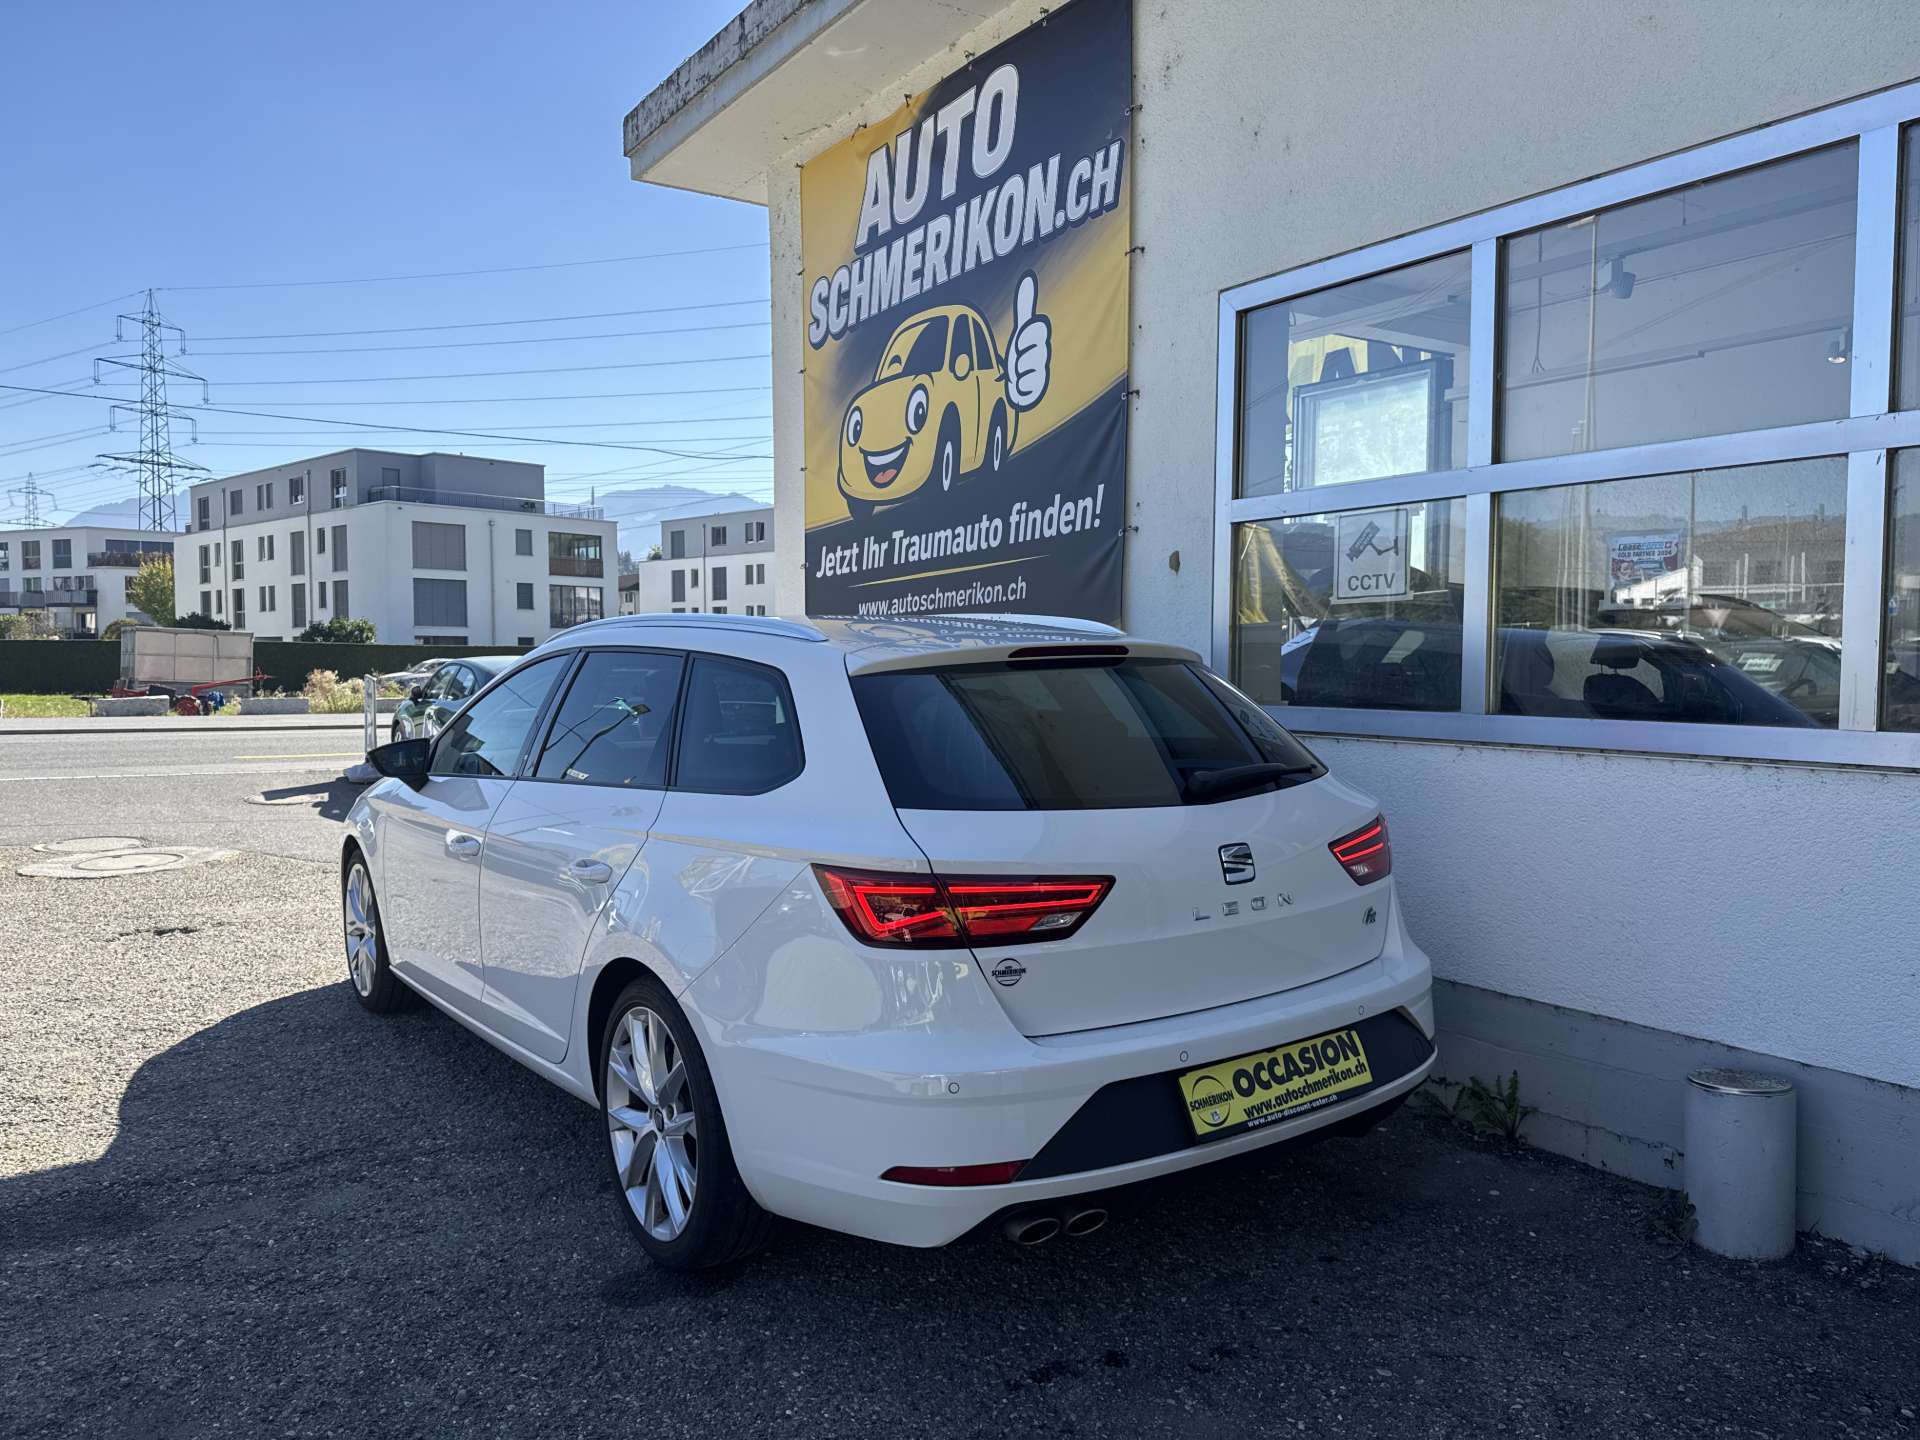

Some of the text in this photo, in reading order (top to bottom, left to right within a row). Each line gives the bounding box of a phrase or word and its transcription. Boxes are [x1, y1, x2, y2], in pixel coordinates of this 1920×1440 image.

[855, 63, 1019, 249] AUTO
[808, 140, 1121, 344] SCHMERIKON.CH
[816, 483, 1104, 578] Jetzt Ihr Traumauto finden!
[858, 576, 1027, 616] www.autoschmerikon.ch
[1347, 573, 1396, 591] CCTV
[1193, 892, 1293, 921] LEON
[1233, 1031, 1361, 1098] OCCASION
[1243, 1059, 1368, 1119] www.autoschmerikon.ch
